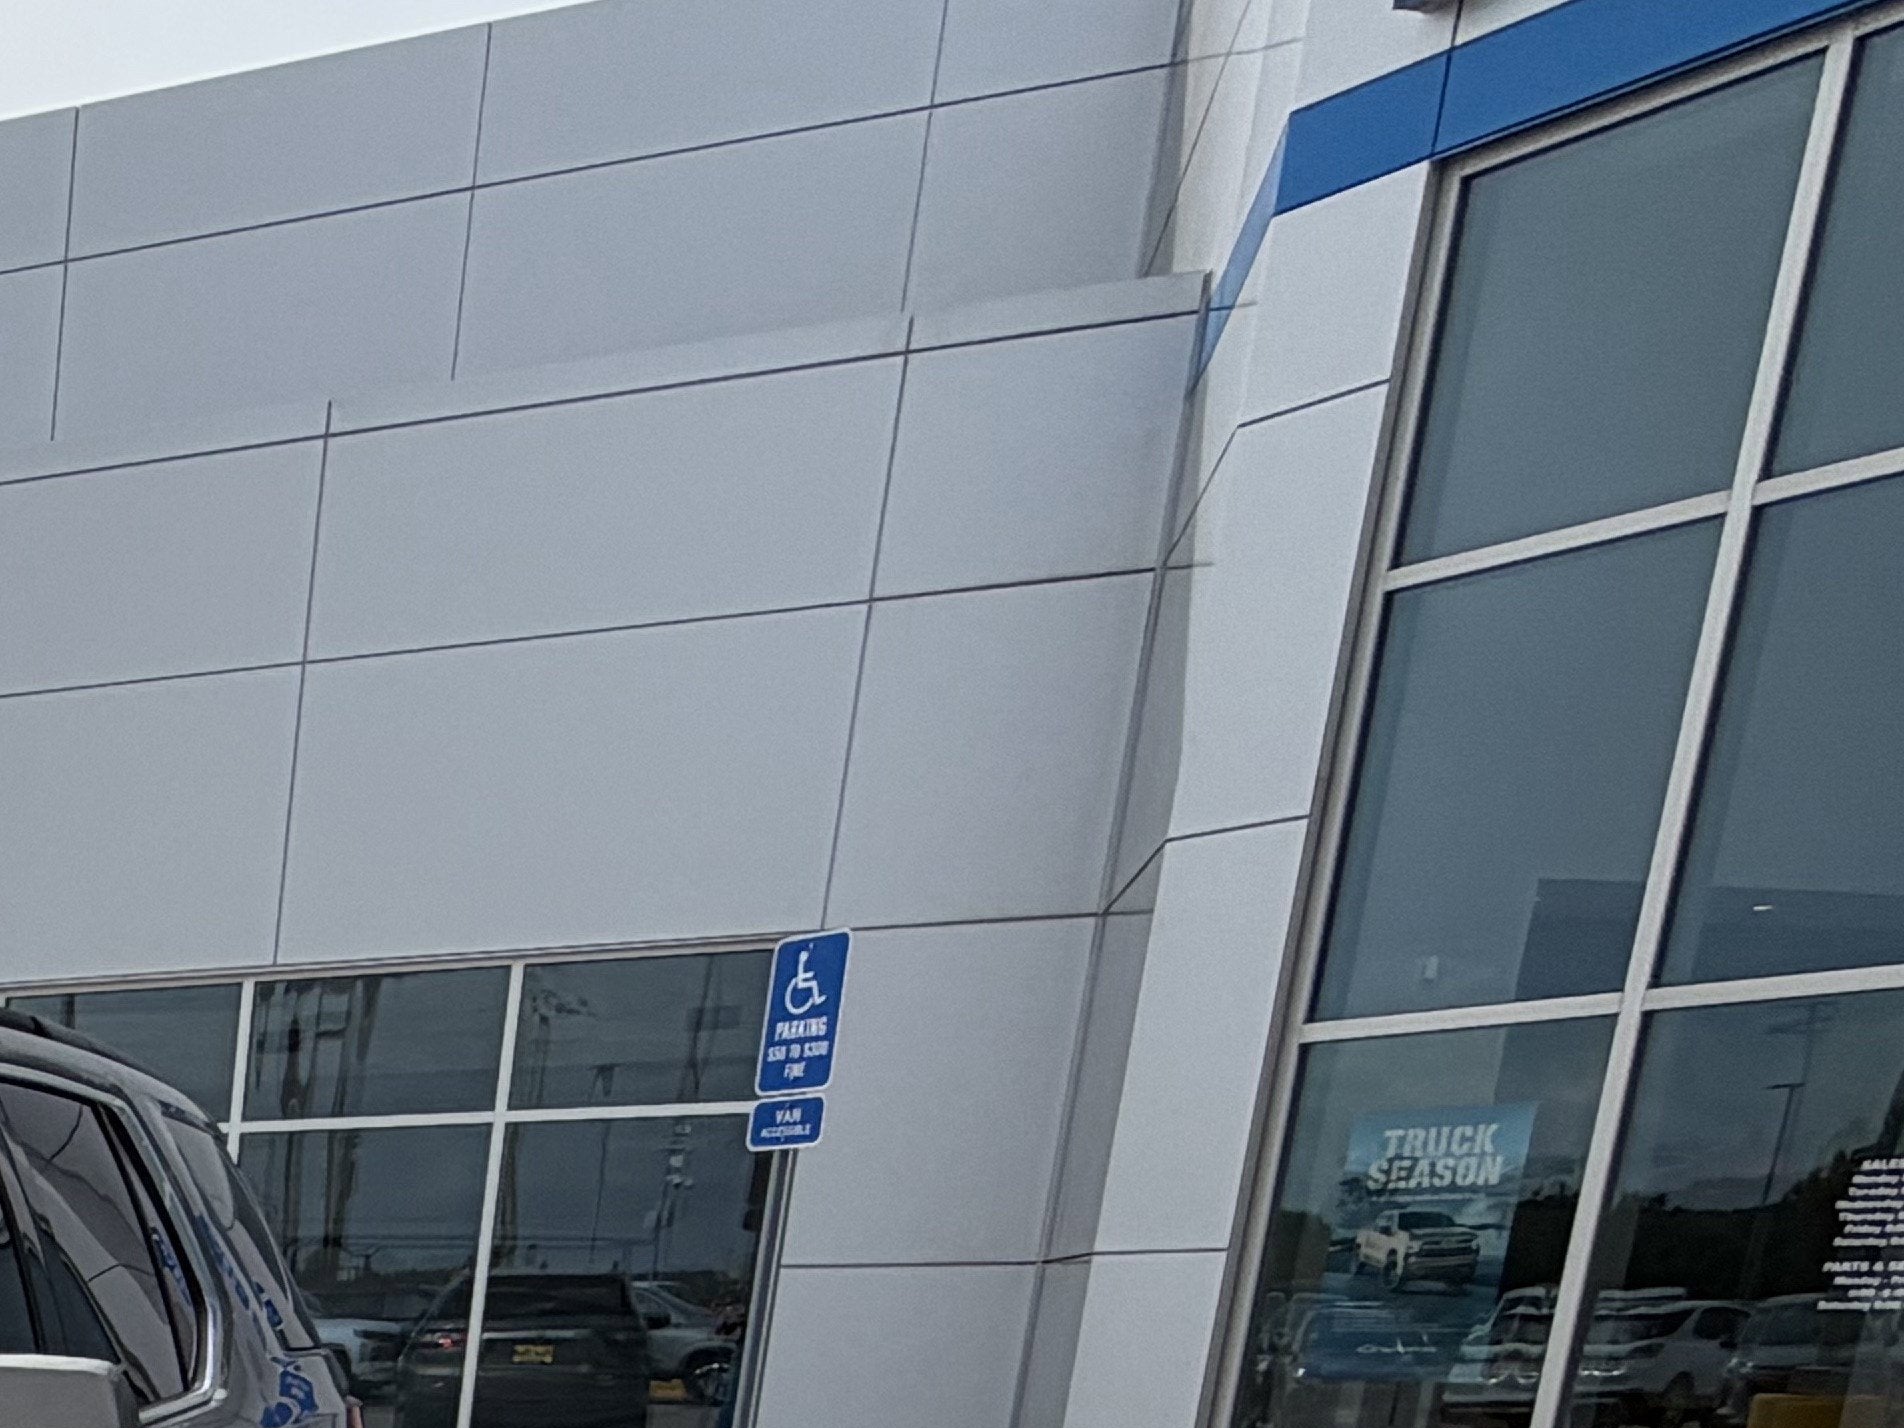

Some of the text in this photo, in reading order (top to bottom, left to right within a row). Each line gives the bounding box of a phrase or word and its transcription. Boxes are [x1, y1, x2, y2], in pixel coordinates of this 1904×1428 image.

[774, 1015, 828, 1041] PARKING
[789, 1043, 801, 1059] TO
[775, 1107, 802, 1124] VAN
[1383, 1123, 1501, 1158] TRUCK
[1366, 1155, 1504, 1190] SEASON
